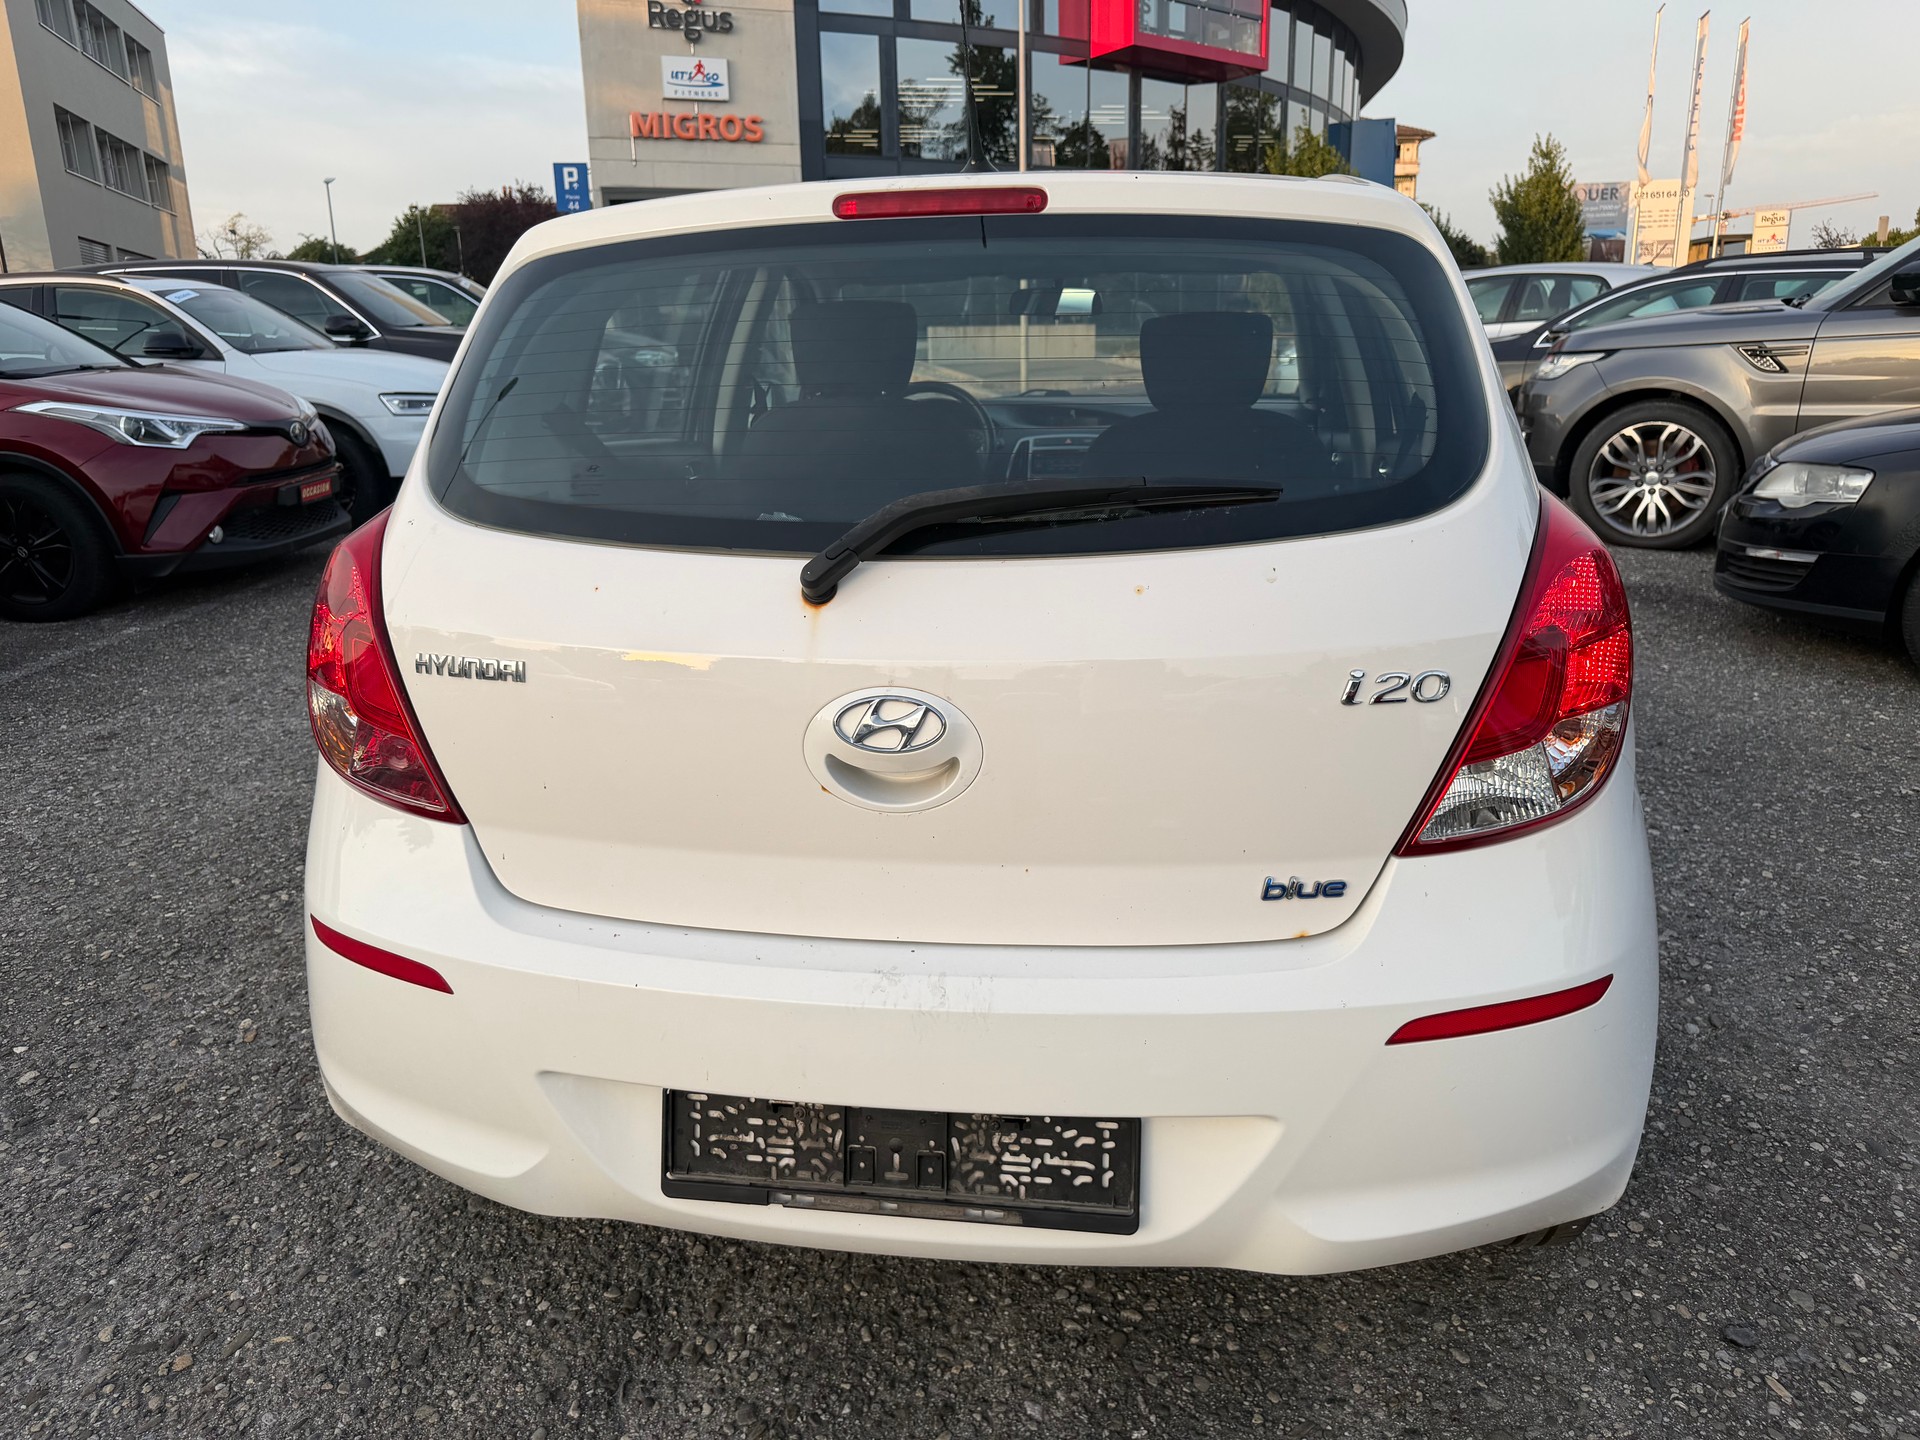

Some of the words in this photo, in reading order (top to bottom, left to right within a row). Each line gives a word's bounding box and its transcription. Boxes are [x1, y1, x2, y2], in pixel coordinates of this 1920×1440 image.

[648, 0, 734, 43] Regus
[704, 73, 720, 82] GO
[674, 89, 720, 97] FITNESS
[630, 111, 764, 143] MIGROS
[563, 166, 579, 190] P
[1761, 214, 1786, 225] Regus
[302, 481, 331, 498] OCCASION
[415, 652, 526, 683] HYUNDAI
[1340, 668, 1451, 706] i20
[1261, 876, 1347, 901] blue
